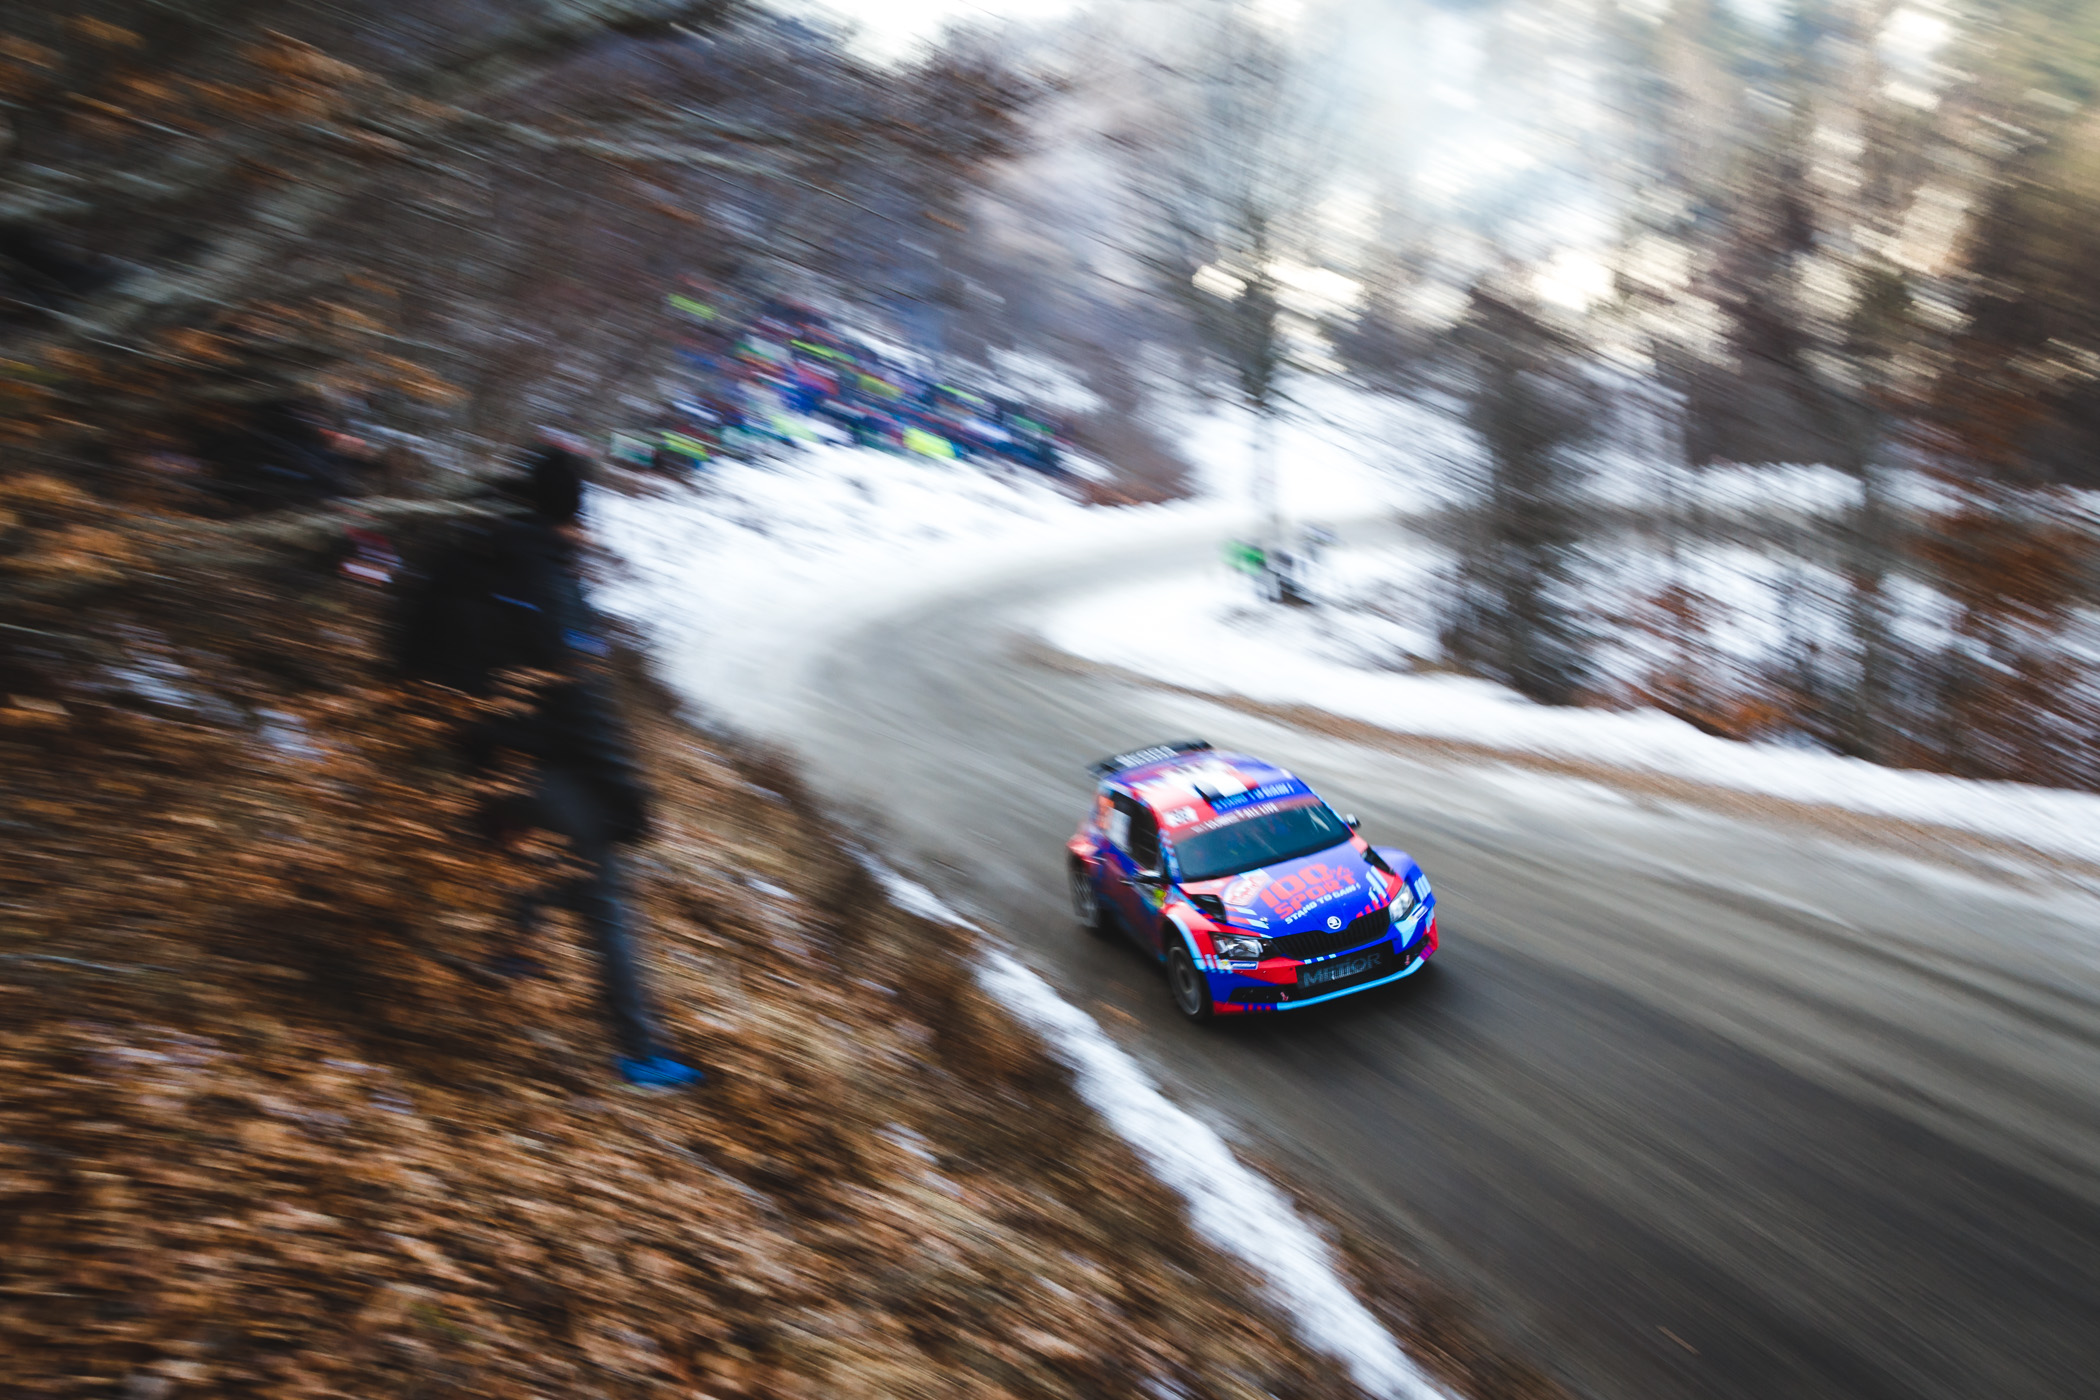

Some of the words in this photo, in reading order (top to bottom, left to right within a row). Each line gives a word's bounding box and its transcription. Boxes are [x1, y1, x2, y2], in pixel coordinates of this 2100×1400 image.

[1259, 863, 1355, 909] 100%
[1274, 873, 1357, 920] SPORT
[1284, 901, 1318, 925] STAND
[1316, 893, 1333, 905] TO
